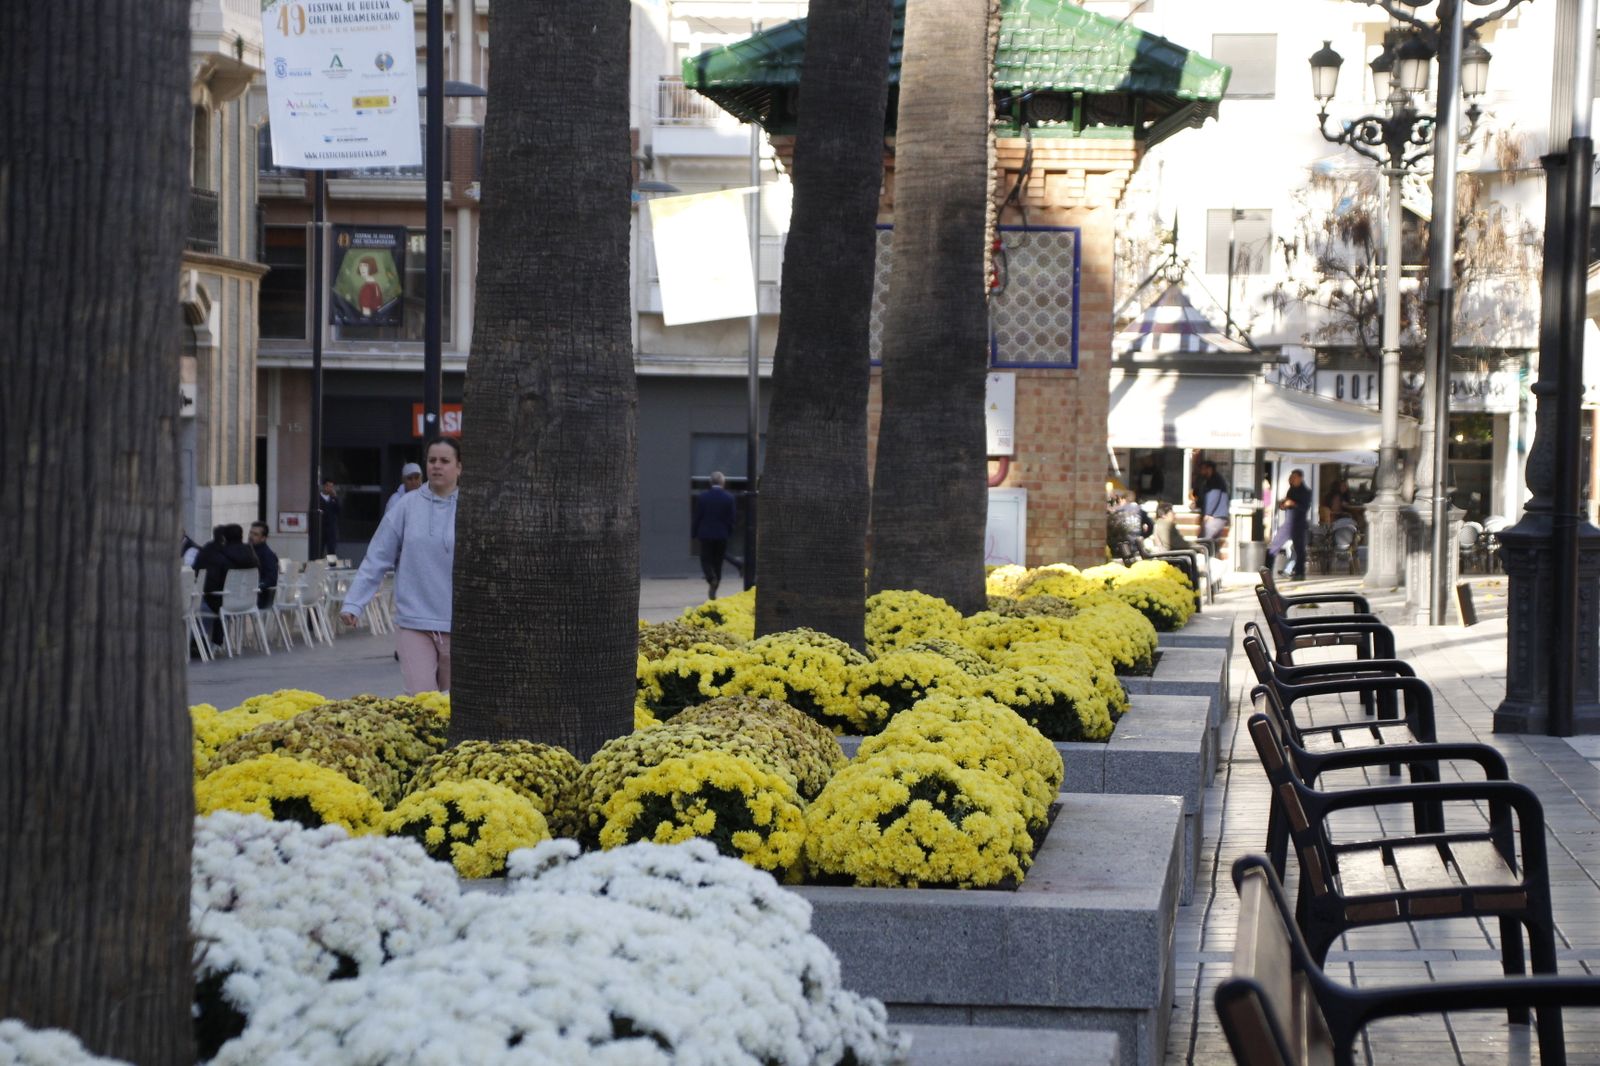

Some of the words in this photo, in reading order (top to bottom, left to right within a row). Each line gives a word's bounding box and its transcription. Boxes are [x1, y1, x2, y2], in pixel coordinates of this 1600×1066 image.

[308, 1, 344, 13] FESTIVAL
[347, 1, 356, 11] DE
[359, 0, 390, 11] HUELVA
[277, 3, 306, 36] 49
[308, 14, 327, 25] CINE
[330, 11, 400, 24] IBEROAMERICANO
